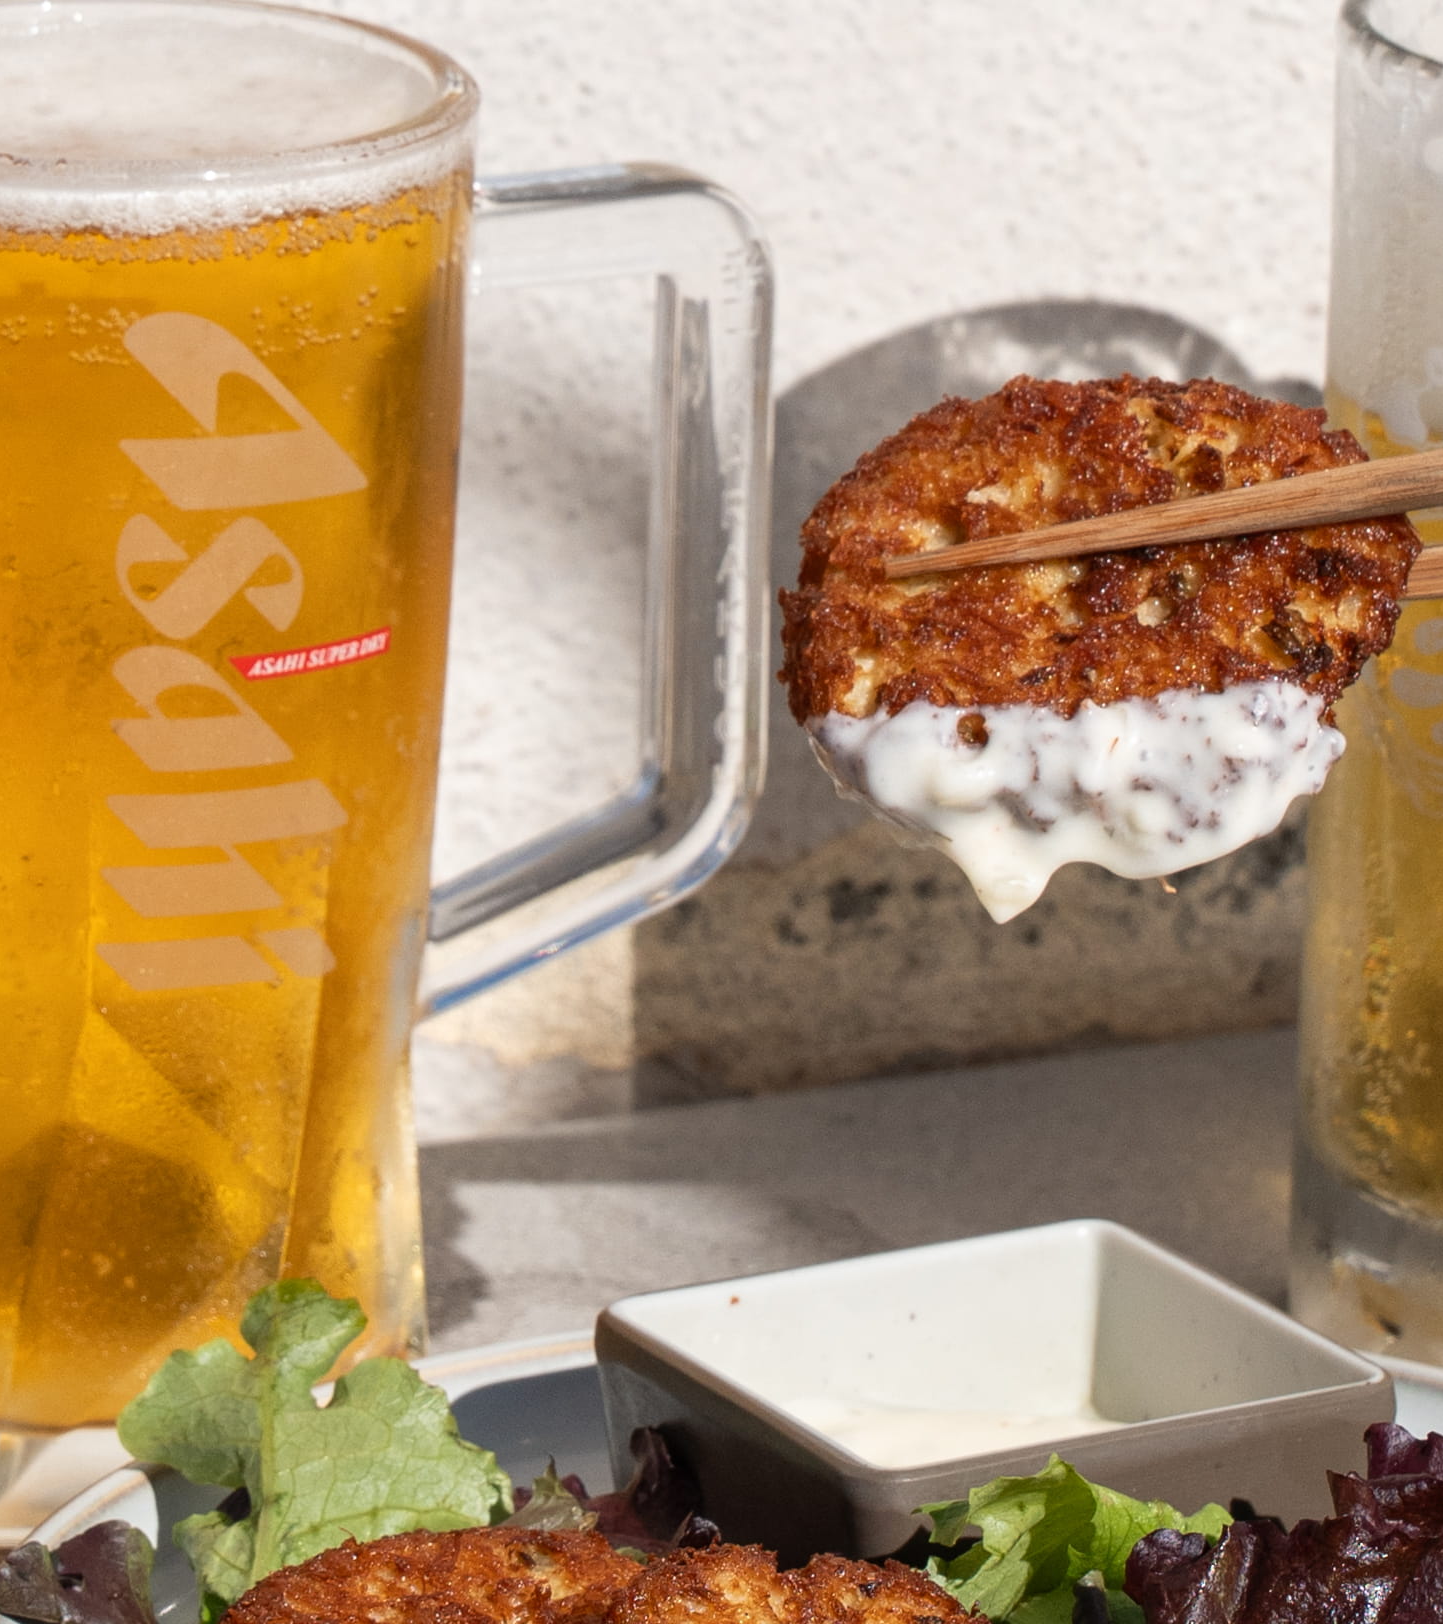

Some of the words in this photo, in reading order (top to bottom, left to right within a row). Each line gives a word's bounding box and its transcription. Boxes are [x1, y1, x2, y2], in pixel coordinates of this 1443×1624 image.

[94, 312, 370, 991] Asahi
[247, 652, 305, 677] ASAHI
[307, 638, 359, 668] SUPER
